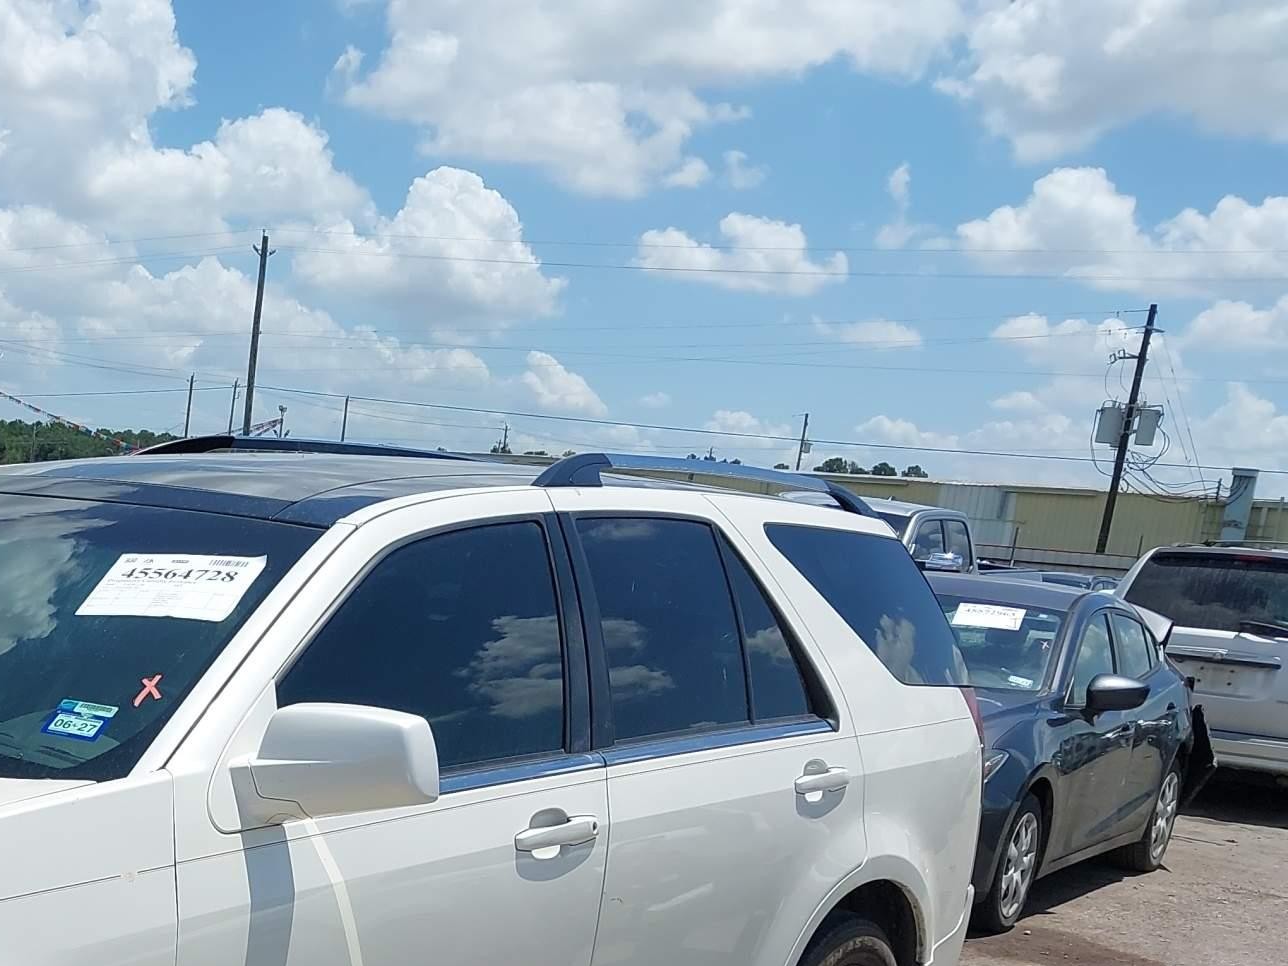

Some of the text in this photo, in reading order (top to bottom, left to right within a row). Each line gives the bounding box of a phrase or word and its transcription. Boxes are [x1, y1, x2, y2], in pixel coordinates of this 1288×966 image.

[121, 567, 239, 583] 45564728
[54, 718, 73, 729] 06
[77, 722, 99, 733] 27
